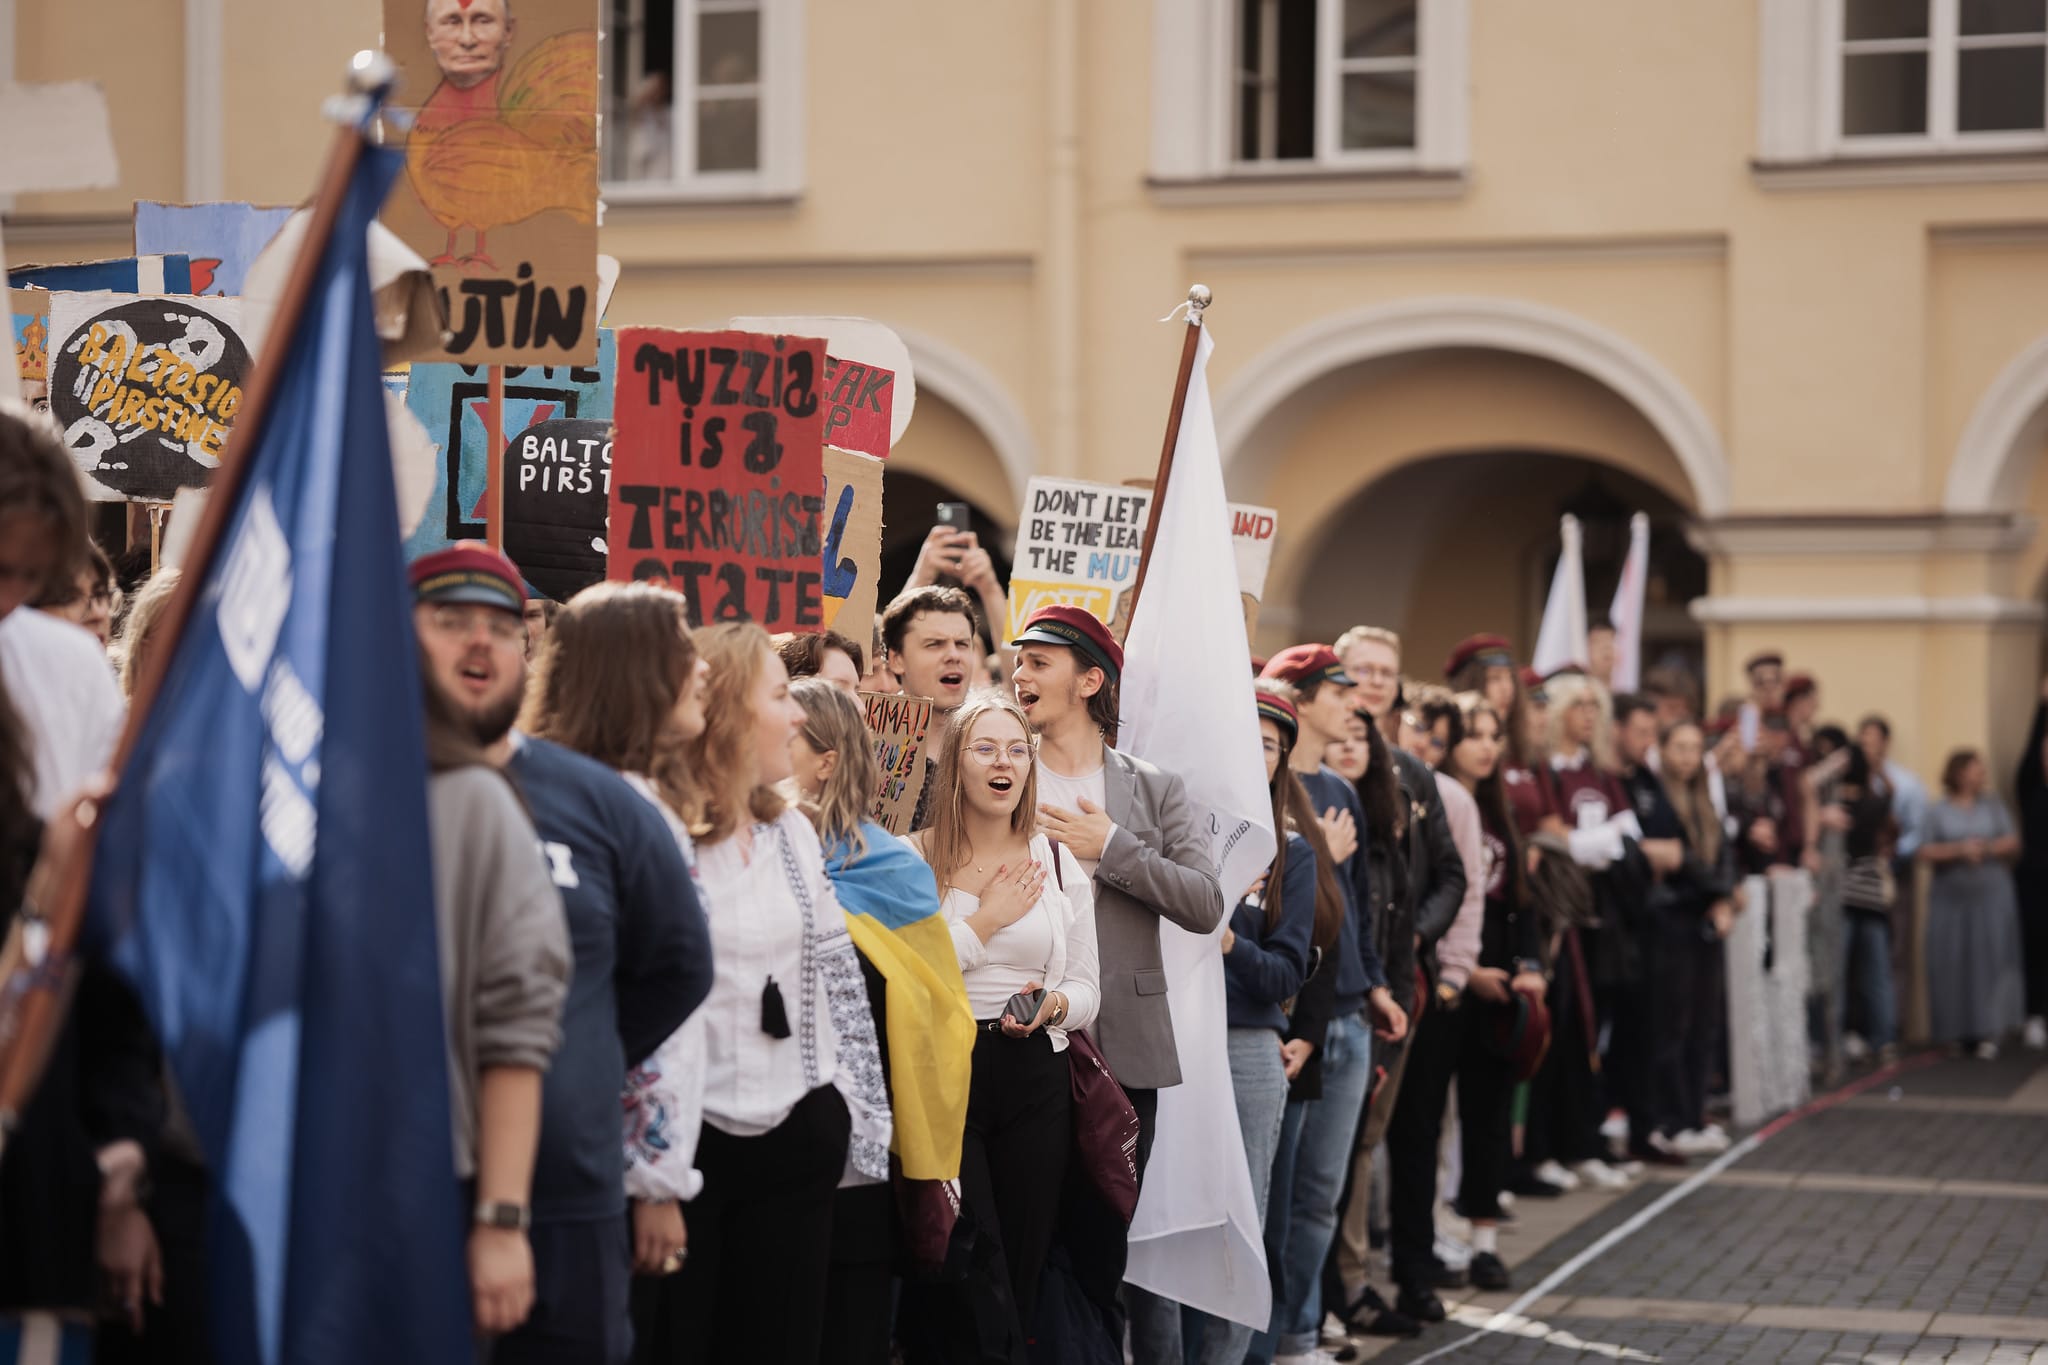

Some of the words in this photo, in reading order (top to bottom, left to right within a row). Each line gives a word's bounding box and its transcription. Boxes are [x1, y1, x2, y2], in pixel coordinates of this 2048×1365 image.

[1033, 489, 1098, 517] DON'T
[1103, 495, 1146, 525] LET
[1030, 519, 1056, 541] BE
[1062, 522, 1103, 547] THE
[1105, 525, 1147, 550] LEA
[1029, 547, 1077, 574] THE
[1087, 552, 1140, 581] MU
